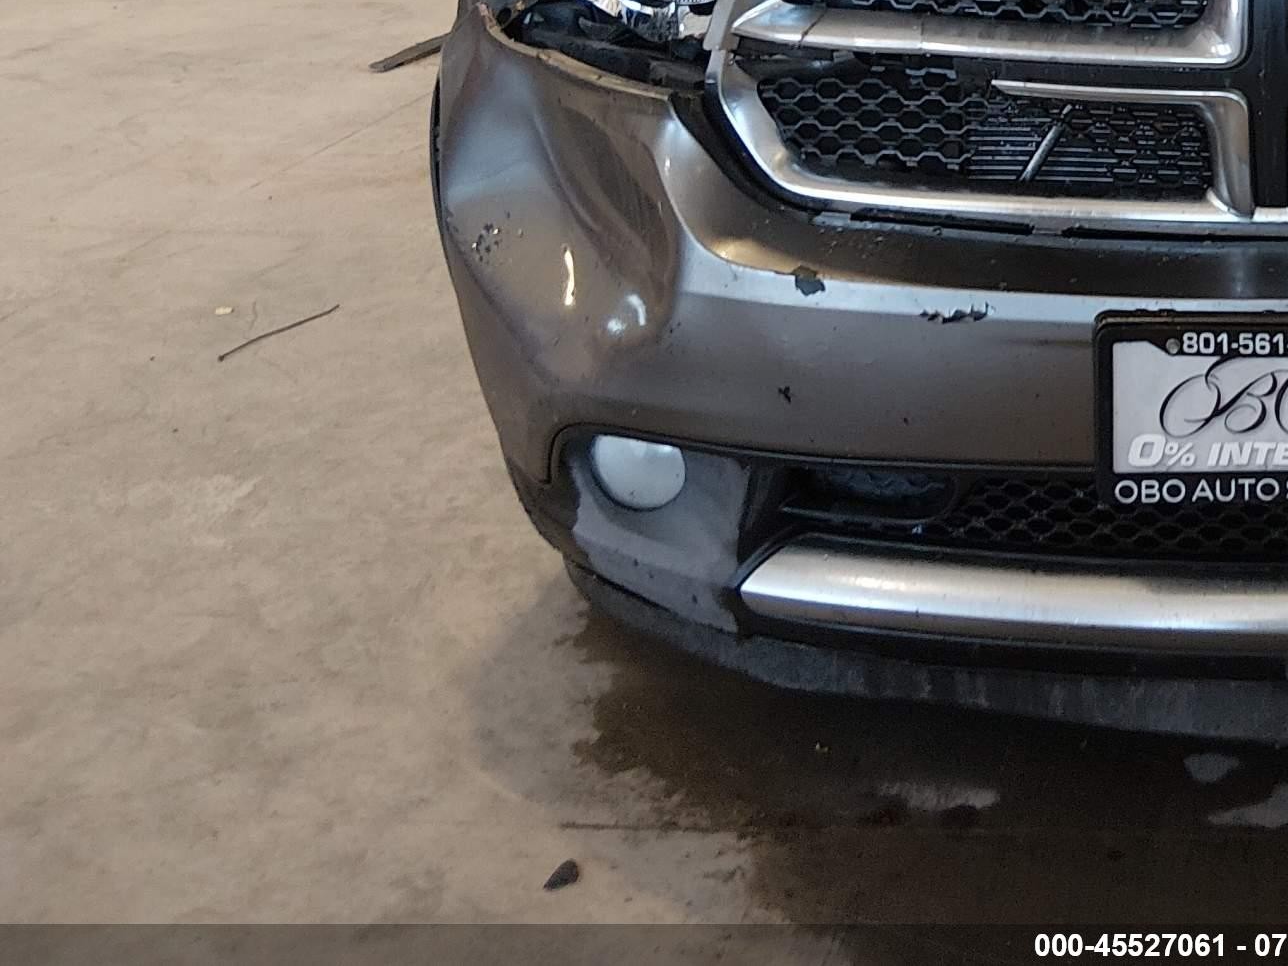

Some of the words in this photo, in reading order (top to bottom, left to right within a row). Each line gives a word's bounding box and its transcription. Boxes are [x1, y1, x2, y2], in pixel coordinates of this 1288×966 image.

[1127, 433, 1196, 467] 0%
[1114, 478, 1186, 504] OBO
[1191, 477, 1280, 502] AUTO
